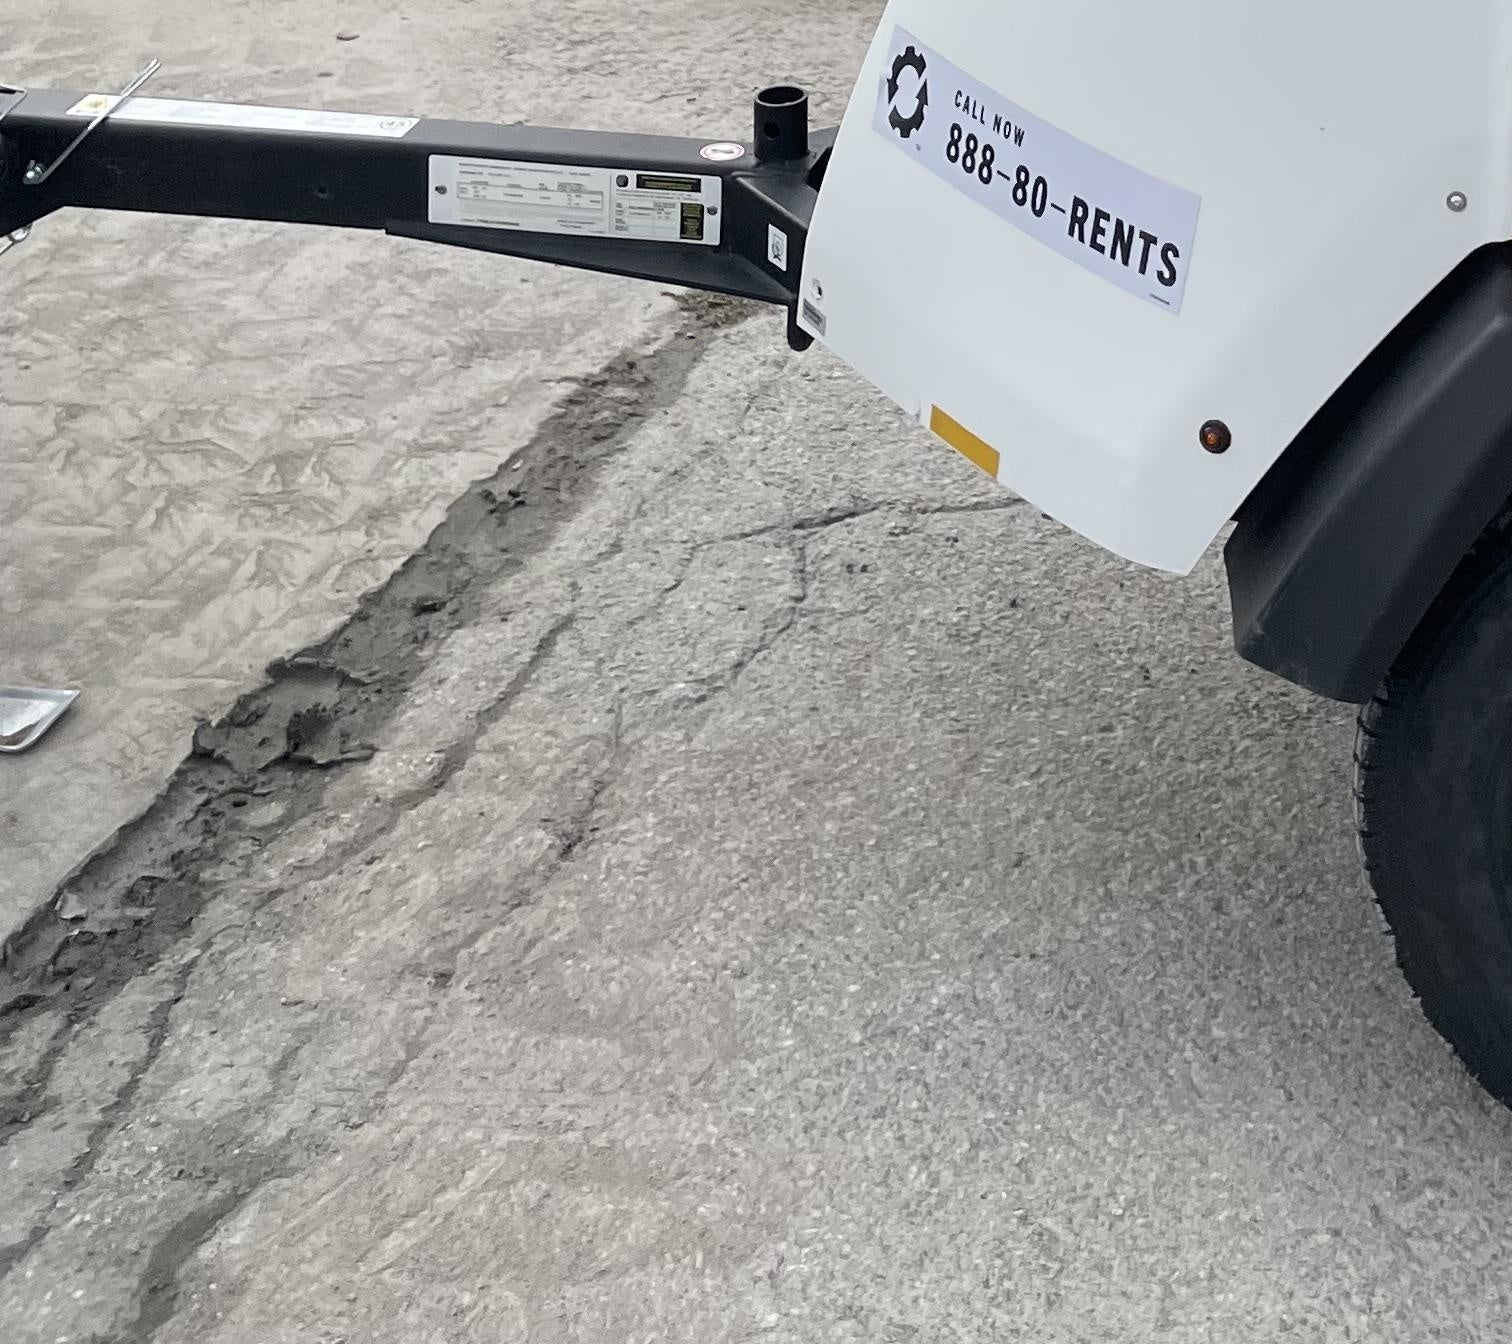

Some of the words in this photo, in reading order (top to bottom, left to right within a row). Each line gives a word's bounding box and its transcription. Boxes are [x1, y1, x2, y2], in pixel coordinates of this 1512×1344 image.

[954, 89, 986, 126] CALL
[992, 113, 1026, 148] NOW
[945, 122, 1181, 288] 888-80-RENTS
